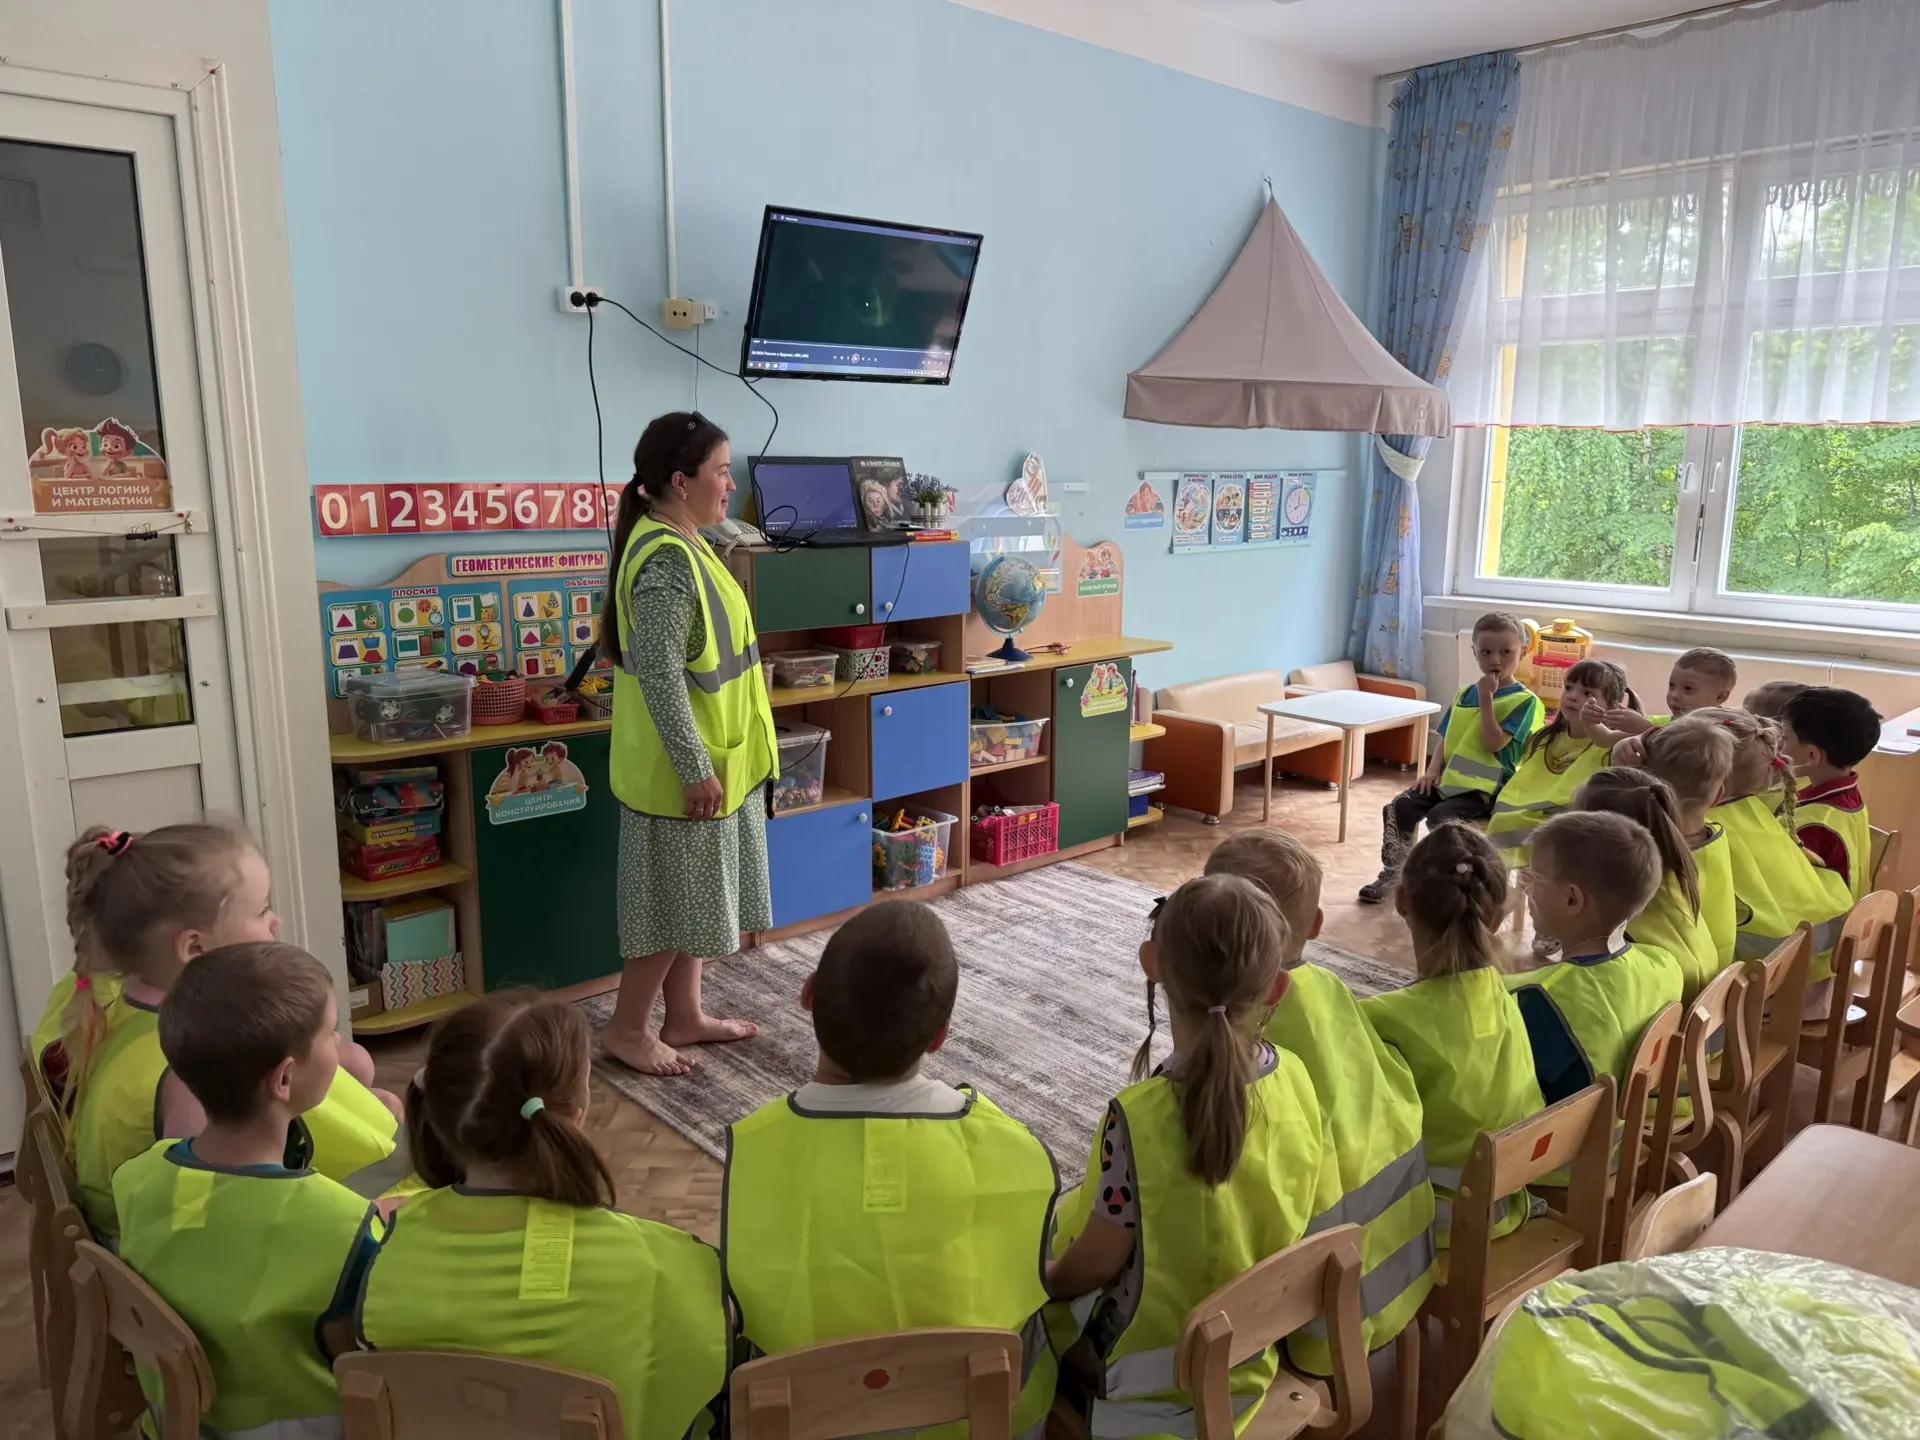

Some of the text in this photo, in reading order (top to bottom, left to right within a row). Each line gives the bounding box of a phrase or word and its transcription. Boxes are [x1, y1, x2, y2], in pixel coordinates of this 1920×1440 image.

[52, 485, 150, 497] ЦЕНТР ЛОГИКИ
[52, 496, 153, 508] И МАТЕМАТИКИ
[455, 553, 604, 572] ГЕОМЕТРИЧЕСКИЕ ФИГУРЫ
[393, 587, 438, 597] ПЛОСКИЕ
[525, 794, 552, 804] ЦЕНТР
[495, 796, 581, 818] КОНСТРУИРОВАНИЯ
